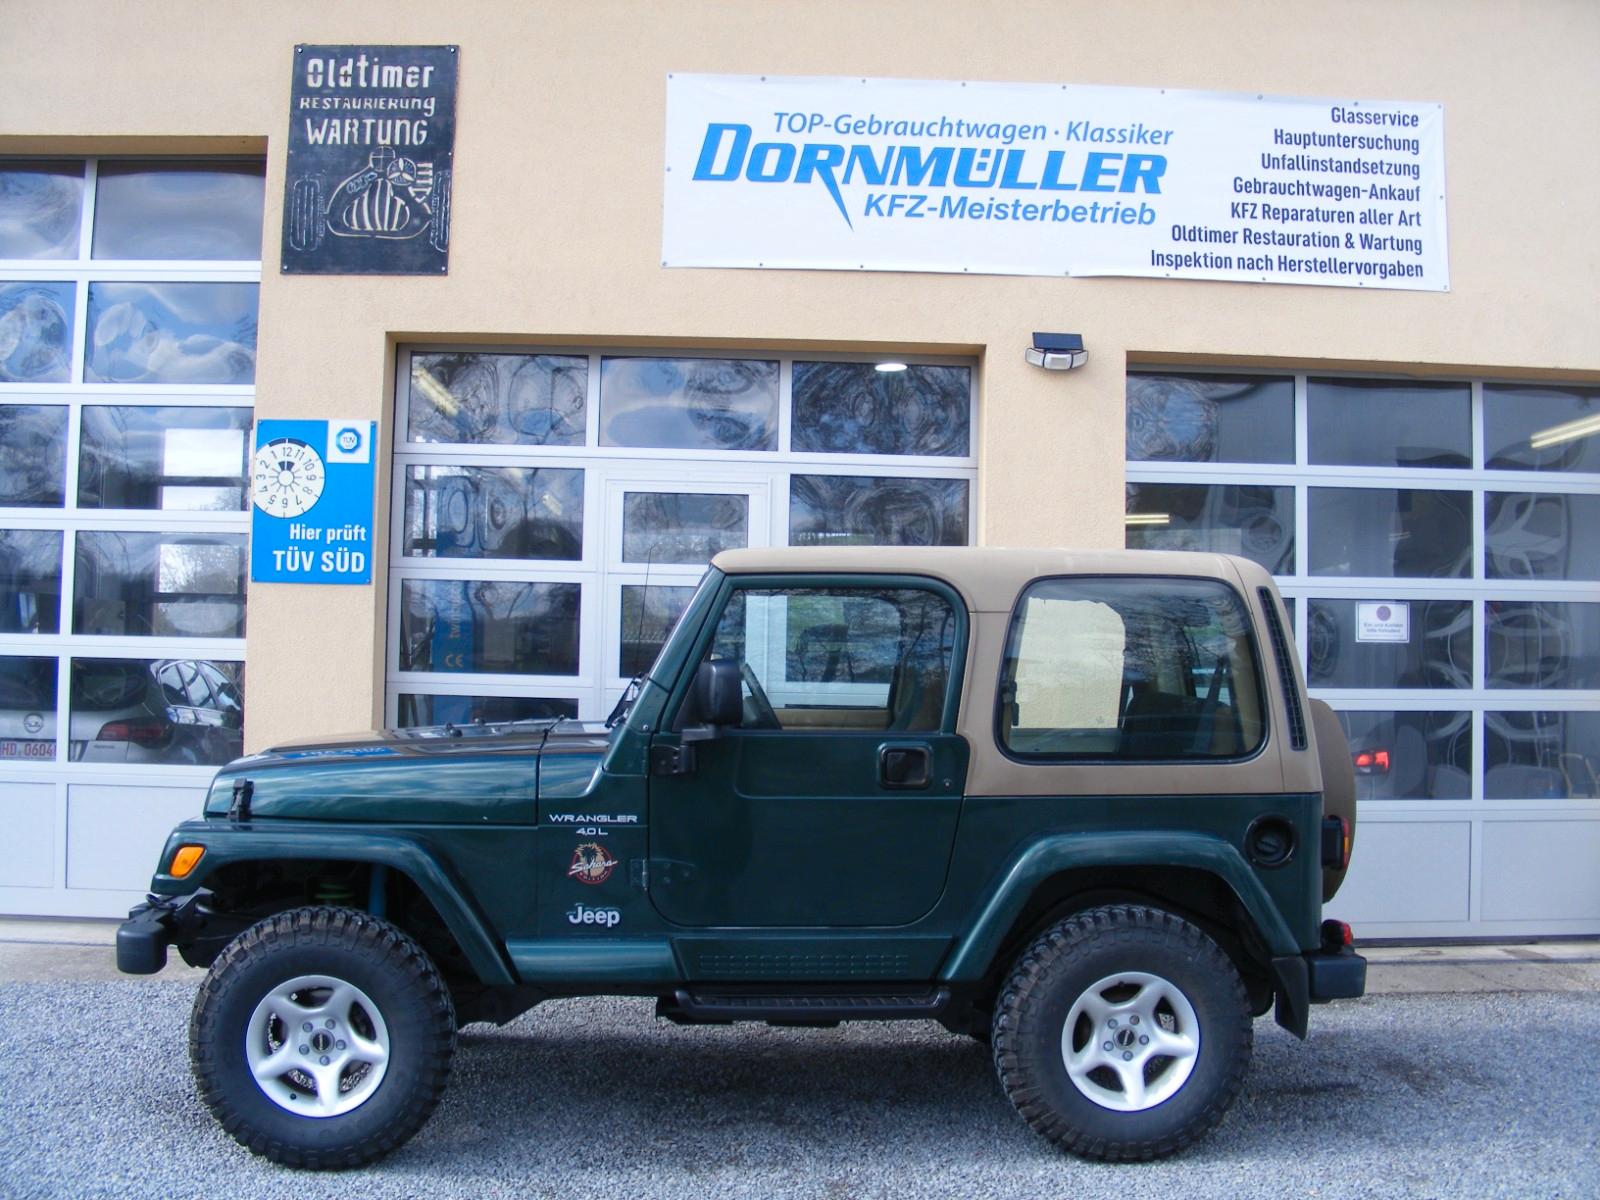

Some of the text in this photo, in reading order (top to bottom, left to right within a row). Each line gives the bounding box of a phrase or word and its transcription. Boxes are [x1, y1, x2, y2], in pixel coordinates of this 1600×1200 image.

[306, 54, 435, 88] Oldtimer
[774, 112, 1174, 145] TOP-Gebrauchtwagen Klassiker
[1331, 106, 1419, 127] Glasservice
[1274, 129, 1420, 155] Hauptuntersuchung
[692, 123, 1168, 232] DORNMÜLLER
[1261, 153, 1420, 180] Unfallinstandsetzung
[1233, 176, 1420, 202] Gebrauchtwagen-Ankauf
[864, 194, 1156, 225] KFZ-Meisterbetrieb
[1231, 202, 1421, 227] KFZ Reparaturen aller Art
[1171, 224, 1422, 255] Oldtimer Restauration & Wartung
[1151, 250, 1424, 279] Inspektion nach Herstellervorgaben
[260, 460, 270, 469] 2
[282, 447, 293, 457] 12
[303, 458, 315, 471] 10
[302, 486, 313, 495] 8
[290, 523, 366, 545] Hier prüft
[272, 546, 366, 573] TÜV SÜD
[2, 743, 57, 757] HD 0604
[549, 814, 638, 823] WRANGLER
[568, 858, 618, 876] Sahara
[568, 905, 621, 928] Jeep
